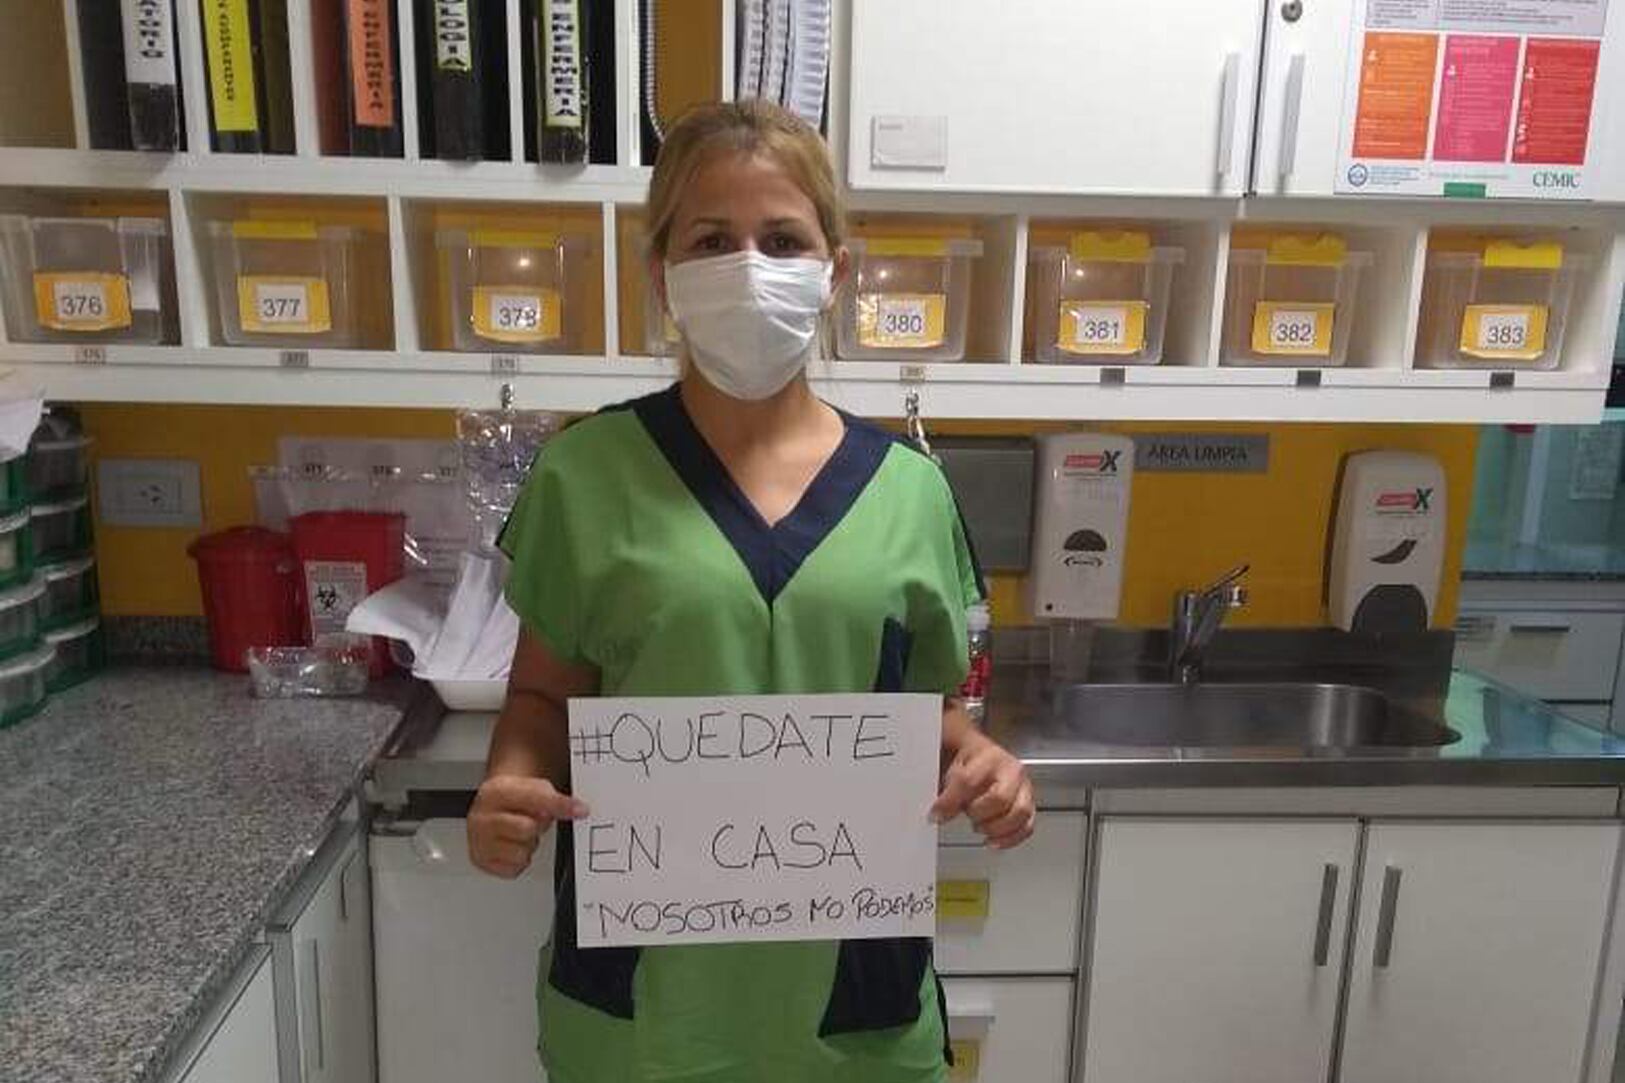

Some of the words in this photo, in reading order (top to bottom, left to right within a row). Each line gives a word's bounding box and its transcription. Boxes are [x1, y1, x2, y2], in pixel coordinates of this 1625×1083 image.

[1532, 171, 1581, 188] CEMIC
[62, 296, 101, 316] 376
[262, 298, 301, 317] 377
[499, 306, 537, 328] 378
[885, 313, 923, 334] 380
[1084, 320, 1119, 340] 381
[1275, 323, 1312, 342] 382
[1486, 325, 1525, 345] 383
[569, 710, 895, 777] #QUEDATE
[588, 823, 662, 874] EN
[711, 822, 864, 872] CASA
[809, 895, 845, 922] NO
